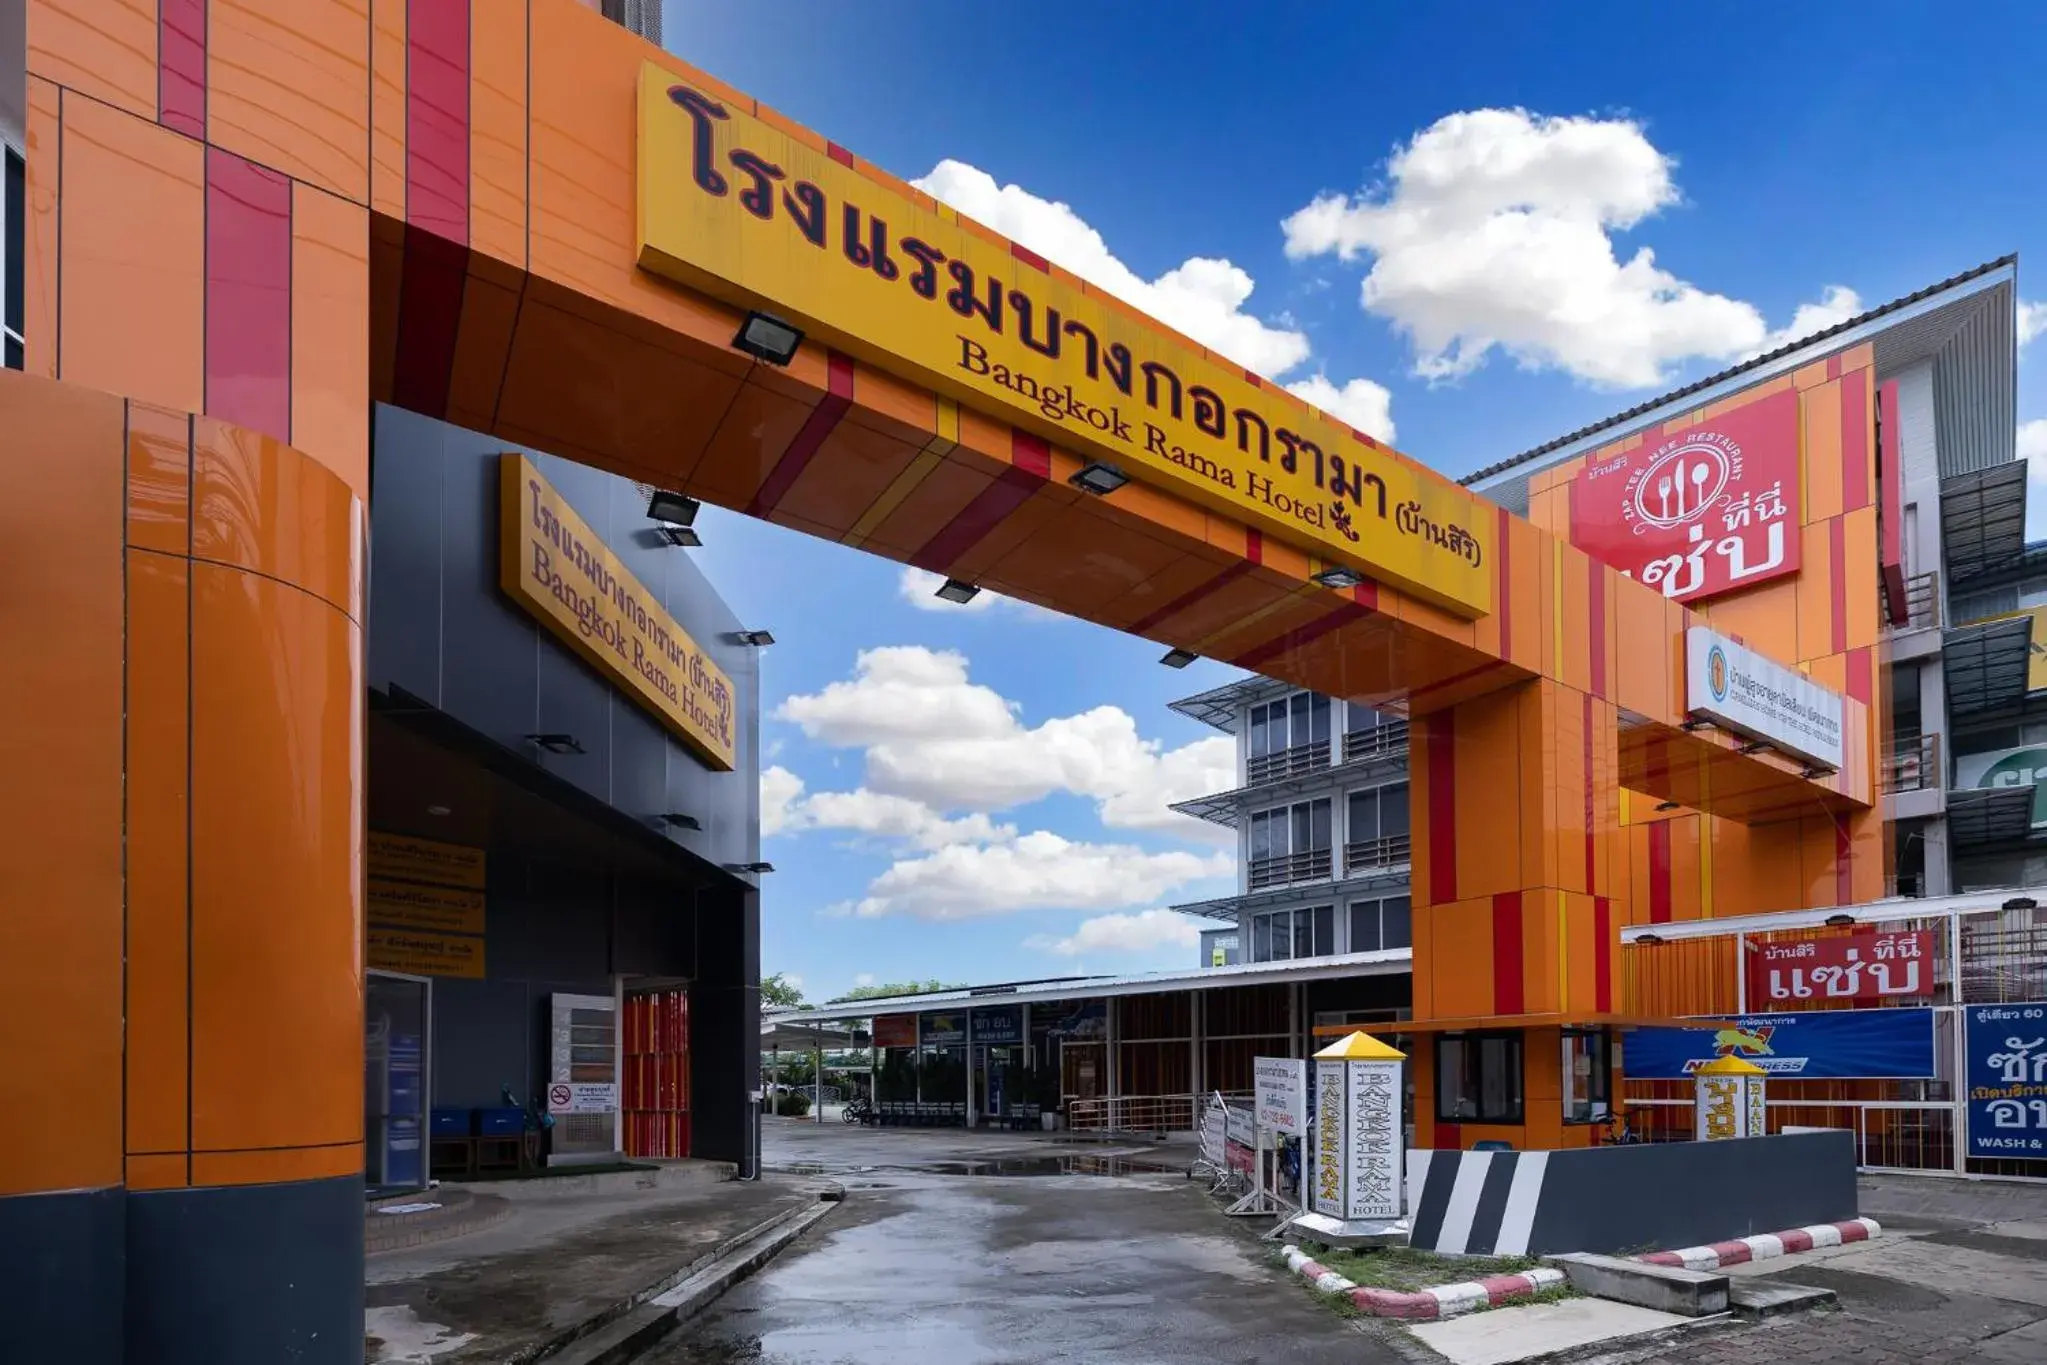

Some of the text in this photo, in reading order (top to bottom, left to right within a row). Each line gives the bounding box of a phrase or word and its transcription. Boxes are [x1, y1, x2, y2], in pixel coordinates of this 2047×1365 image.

[667, 84, 1481, 568] โรงแรมบางกอกรามา (บ้านสิริ)
[957, 335, 1326, 531] Bangkok Rama Hotel
[1687, 432, 1744, 481] RESTAURANT
[528, 479, 687, 675] โรงแรมบางกอกรามา
[1642, 523, 1784, 598] ซ่บ
[531, 539, 719, 742] Bangkok Rama Hotel
[1769, 948, 1920, 999] แซ่บ
[1356, 1073, 1391, 1154] BANGKOK
[1977, 1137, 2043, 1149] WASH &
[1353, 1205, 1395, 1216] HOTEL
